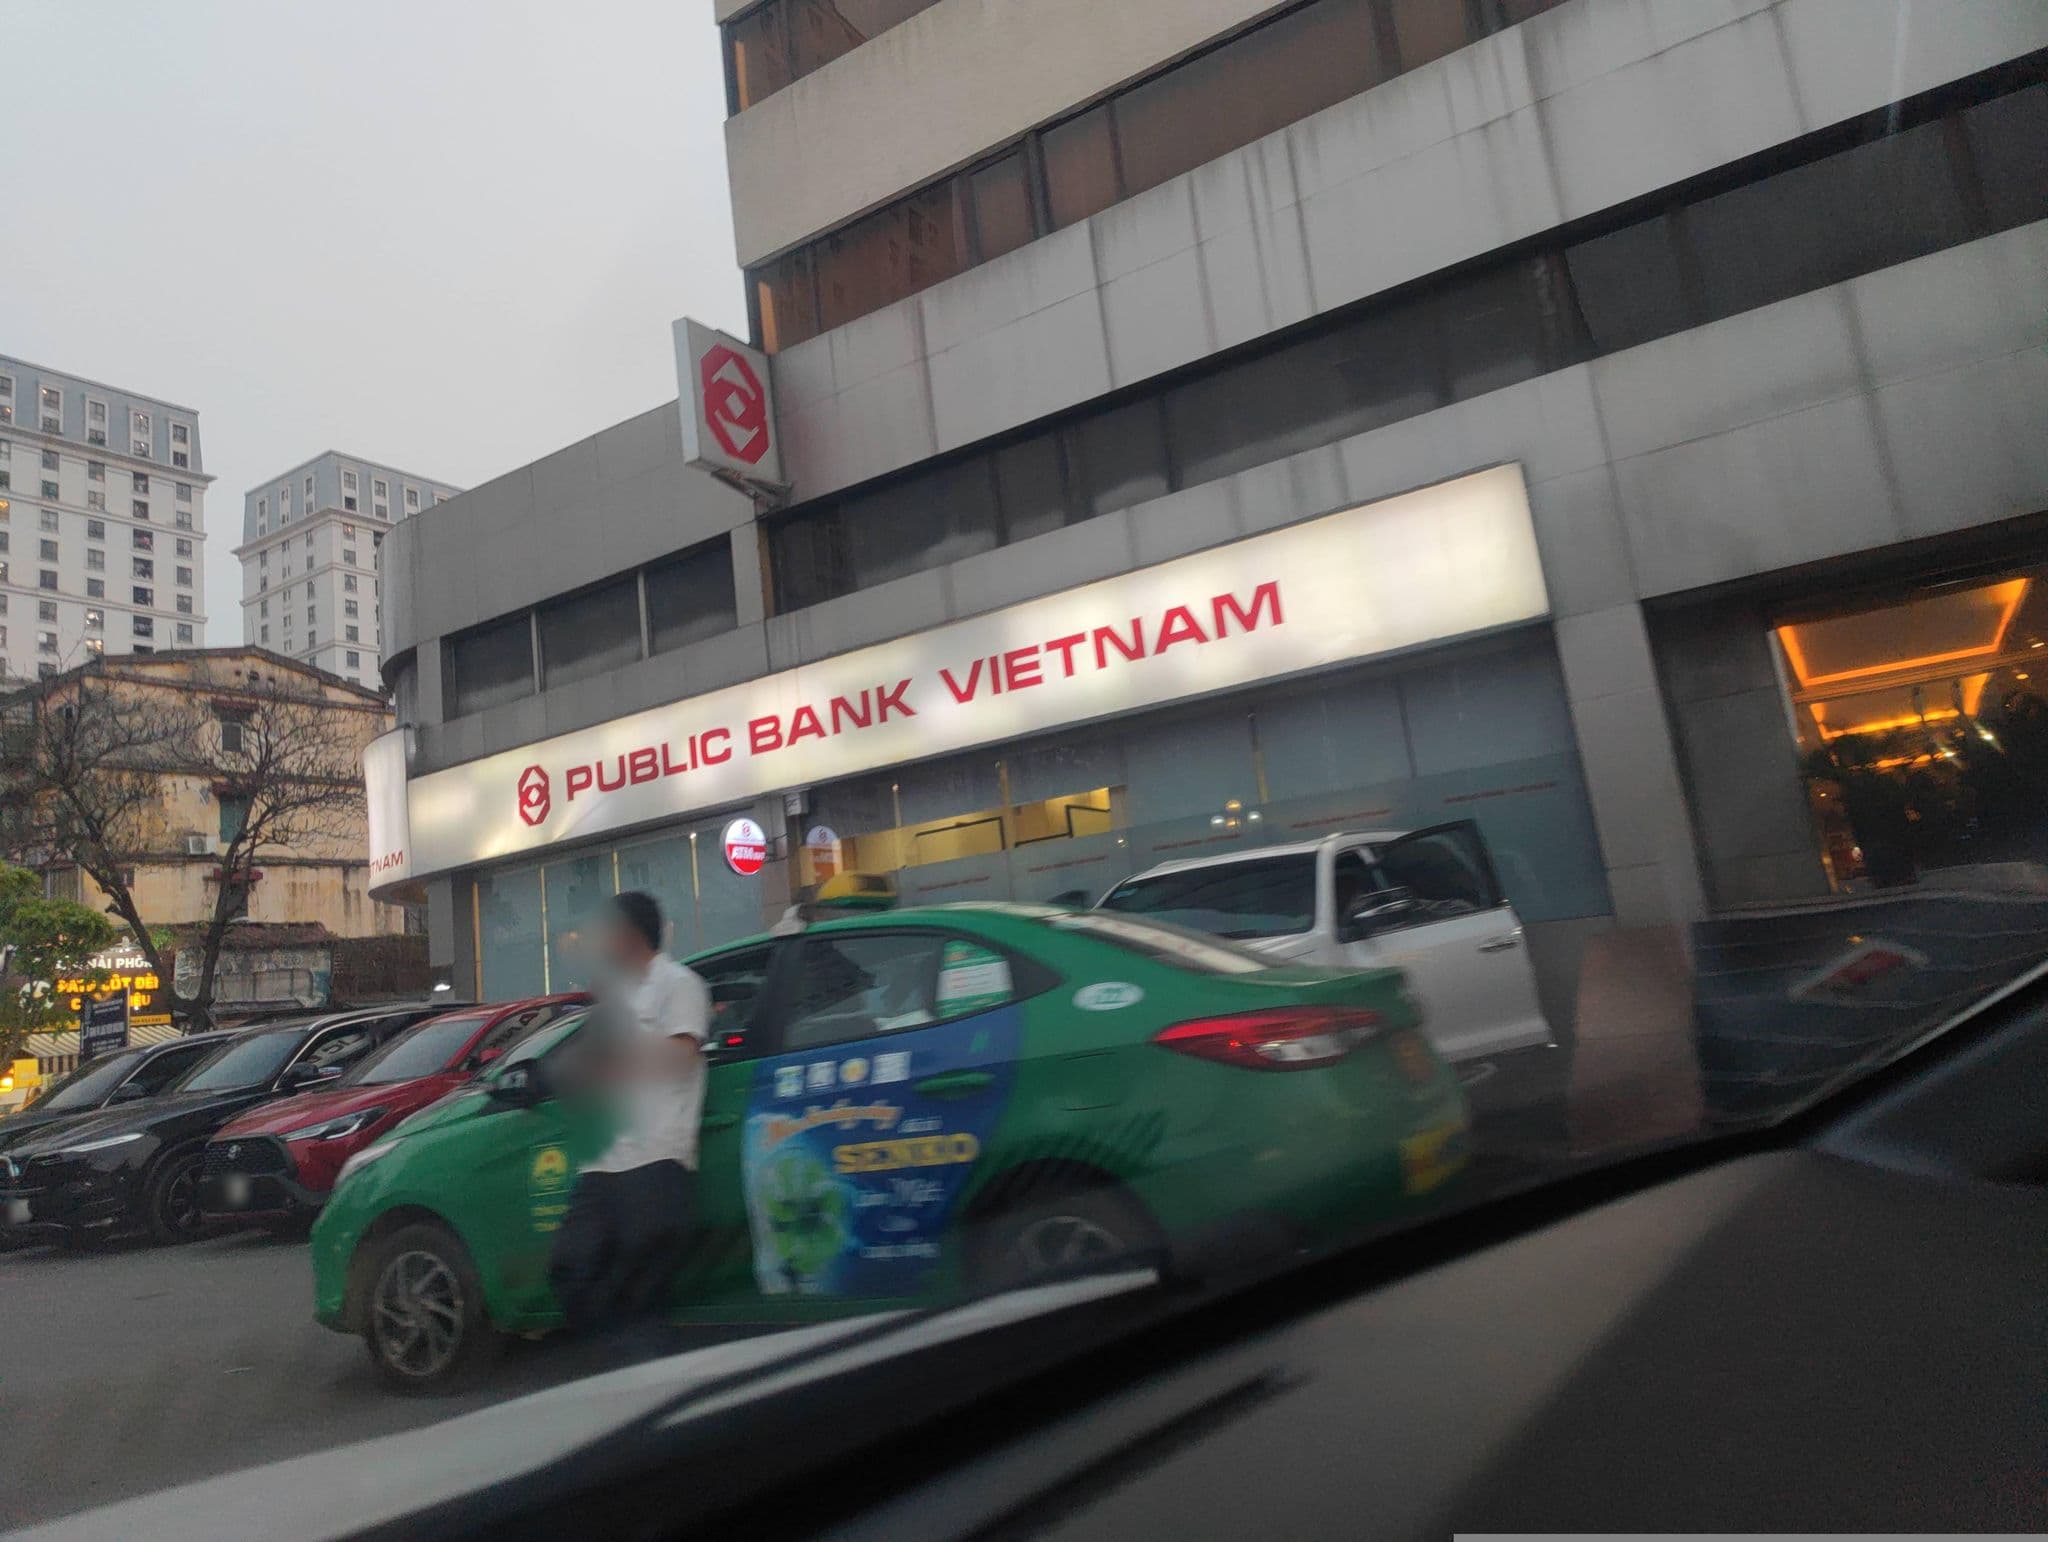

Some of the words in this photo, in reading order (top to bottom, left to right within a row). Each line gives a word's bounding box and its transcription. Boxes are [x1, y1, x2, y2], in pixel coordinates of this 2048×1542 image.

[566, 726, 733, 801] PUBLIC
[748, 680, 915, 756] BANK
[939, 580, 1284, 705] VIETNAM
